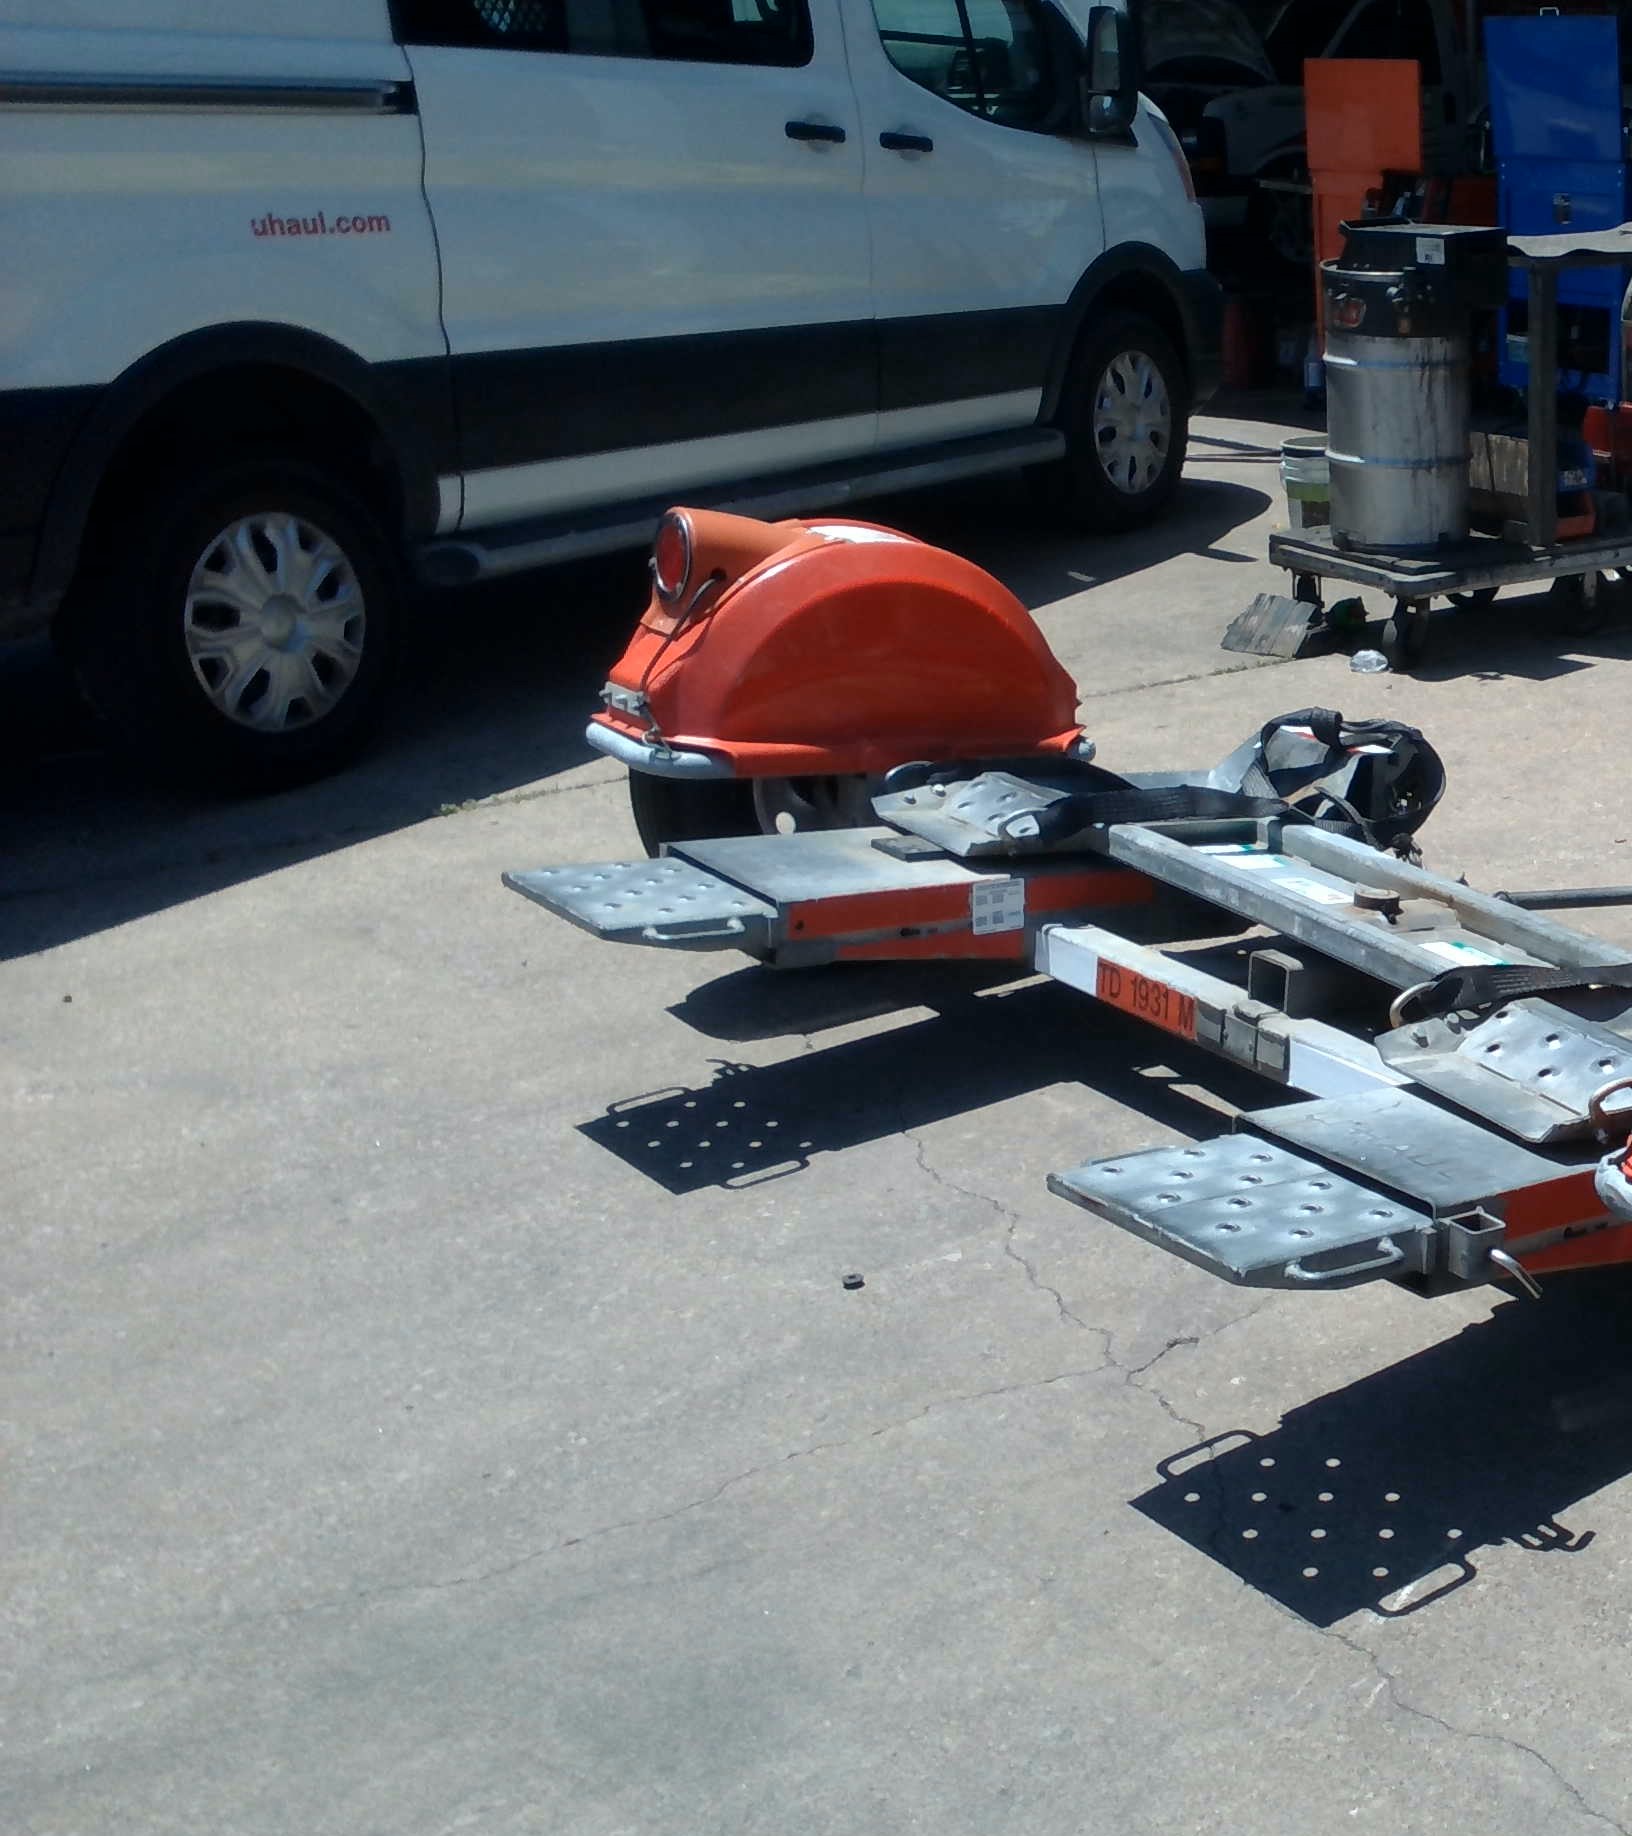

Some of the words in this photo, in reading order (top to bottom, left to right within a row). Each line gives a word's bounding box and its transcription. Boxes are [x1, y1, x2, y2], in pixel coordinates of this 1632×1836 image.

[250, 210, 391, 237] uhaul.com
[1100, 963, 1122, 998] TD
[1131, 975, 1169, 1021] 1931
[1178, 994, 1195, 1032] M
